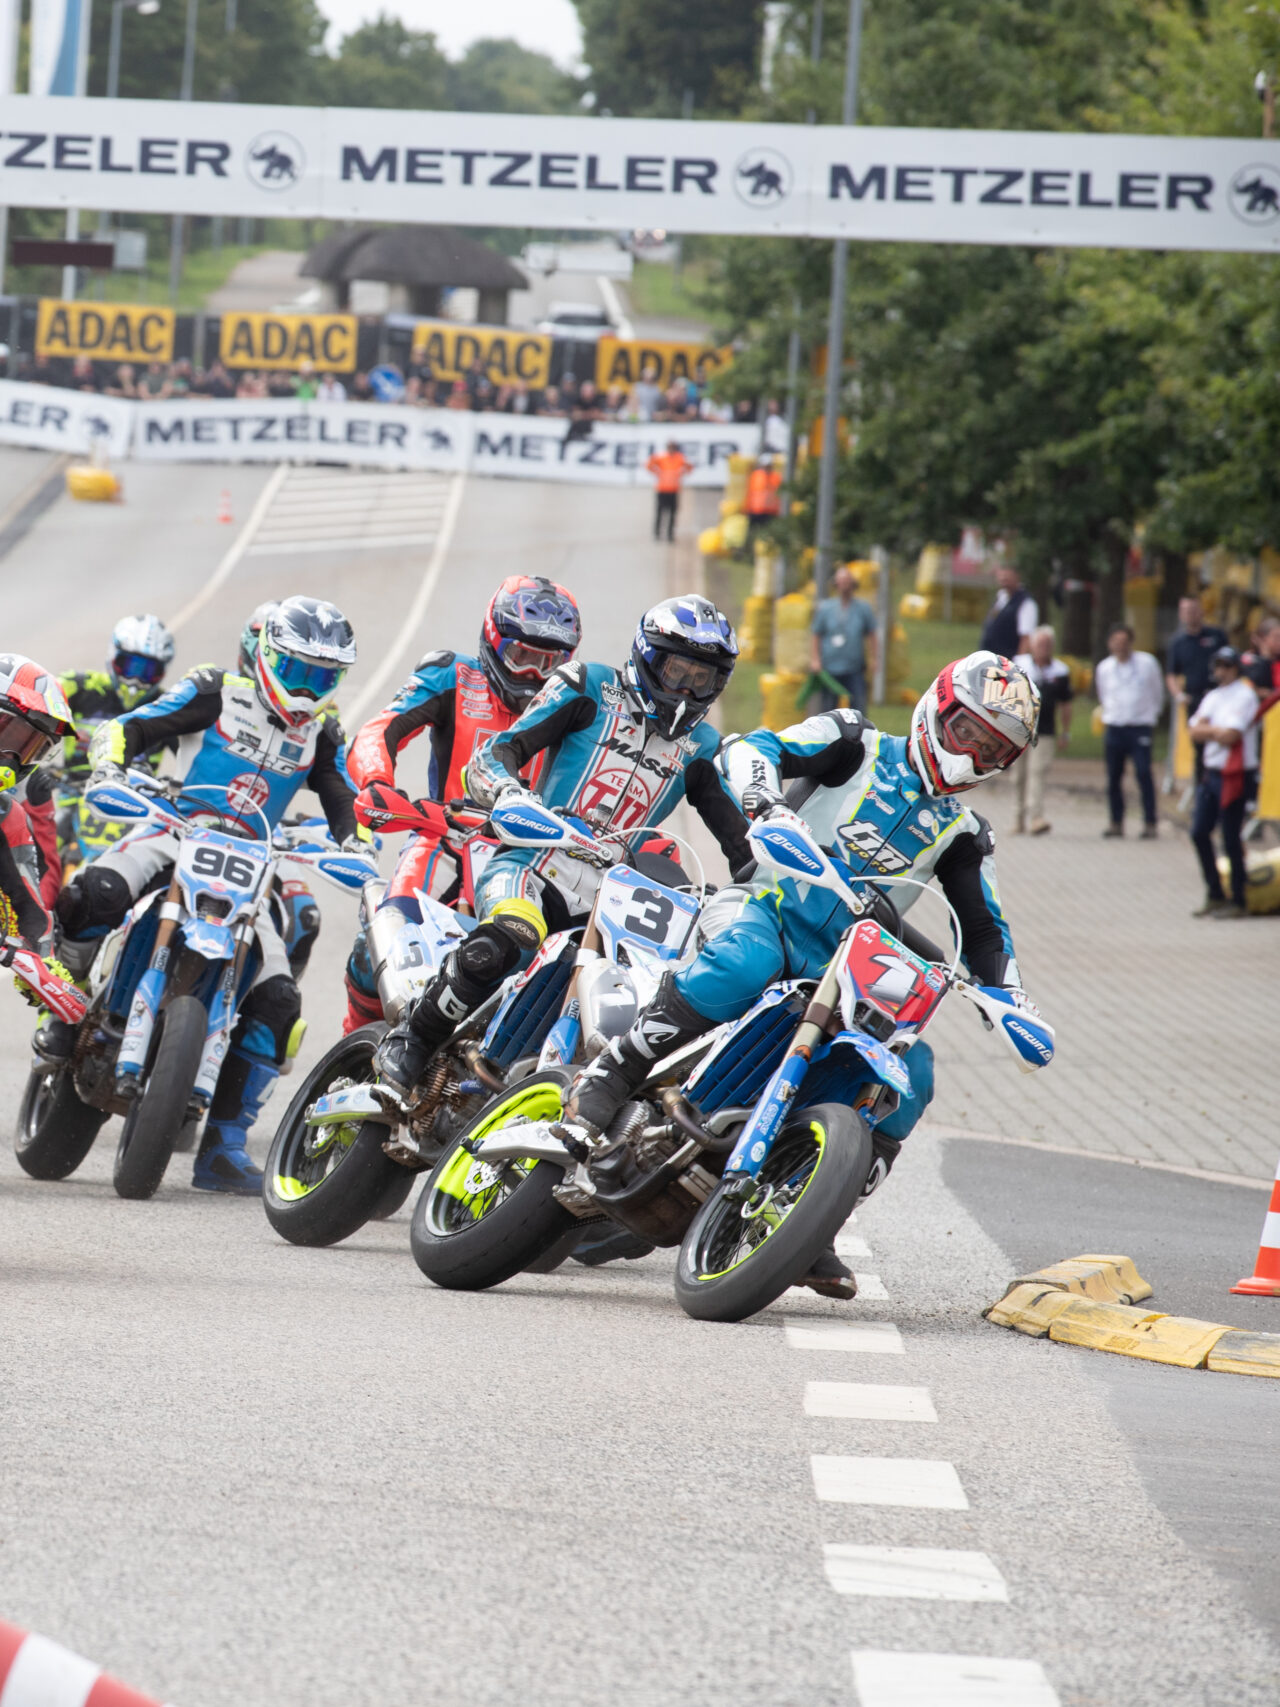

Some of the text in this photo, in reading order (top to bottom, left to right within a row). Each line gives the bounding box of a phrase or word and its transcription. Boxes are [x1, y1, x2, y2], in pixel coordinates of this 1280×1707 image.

[340, 146, 719, 195] METZELER
[827, 163, 1214, 213] METZELER
[46, 309, 167, 356] ADAC
[228, 319, 350, 364] ADAC
[424, 331, 542, 380] ADAC
[146, 414, 409, 449] METZELER
[601, 685, 627, 700] MOTO
[592, 736, 681, 780] MASS
[610, 773, 645, 799] TEAM
[366, 808, 393, 820] UFO
[518, 816, 561, 836] CIRCUIT
[191, 846, 256, 888] 96
[782, 839, 821, 870] CIRCUIT
[845, 841, 888, 874] MOTO
[624, 886, 675, 944] 3
[866, 950, 914, 1011] 1
[1006, 1020, 1045, 1053] CIRCUIT
